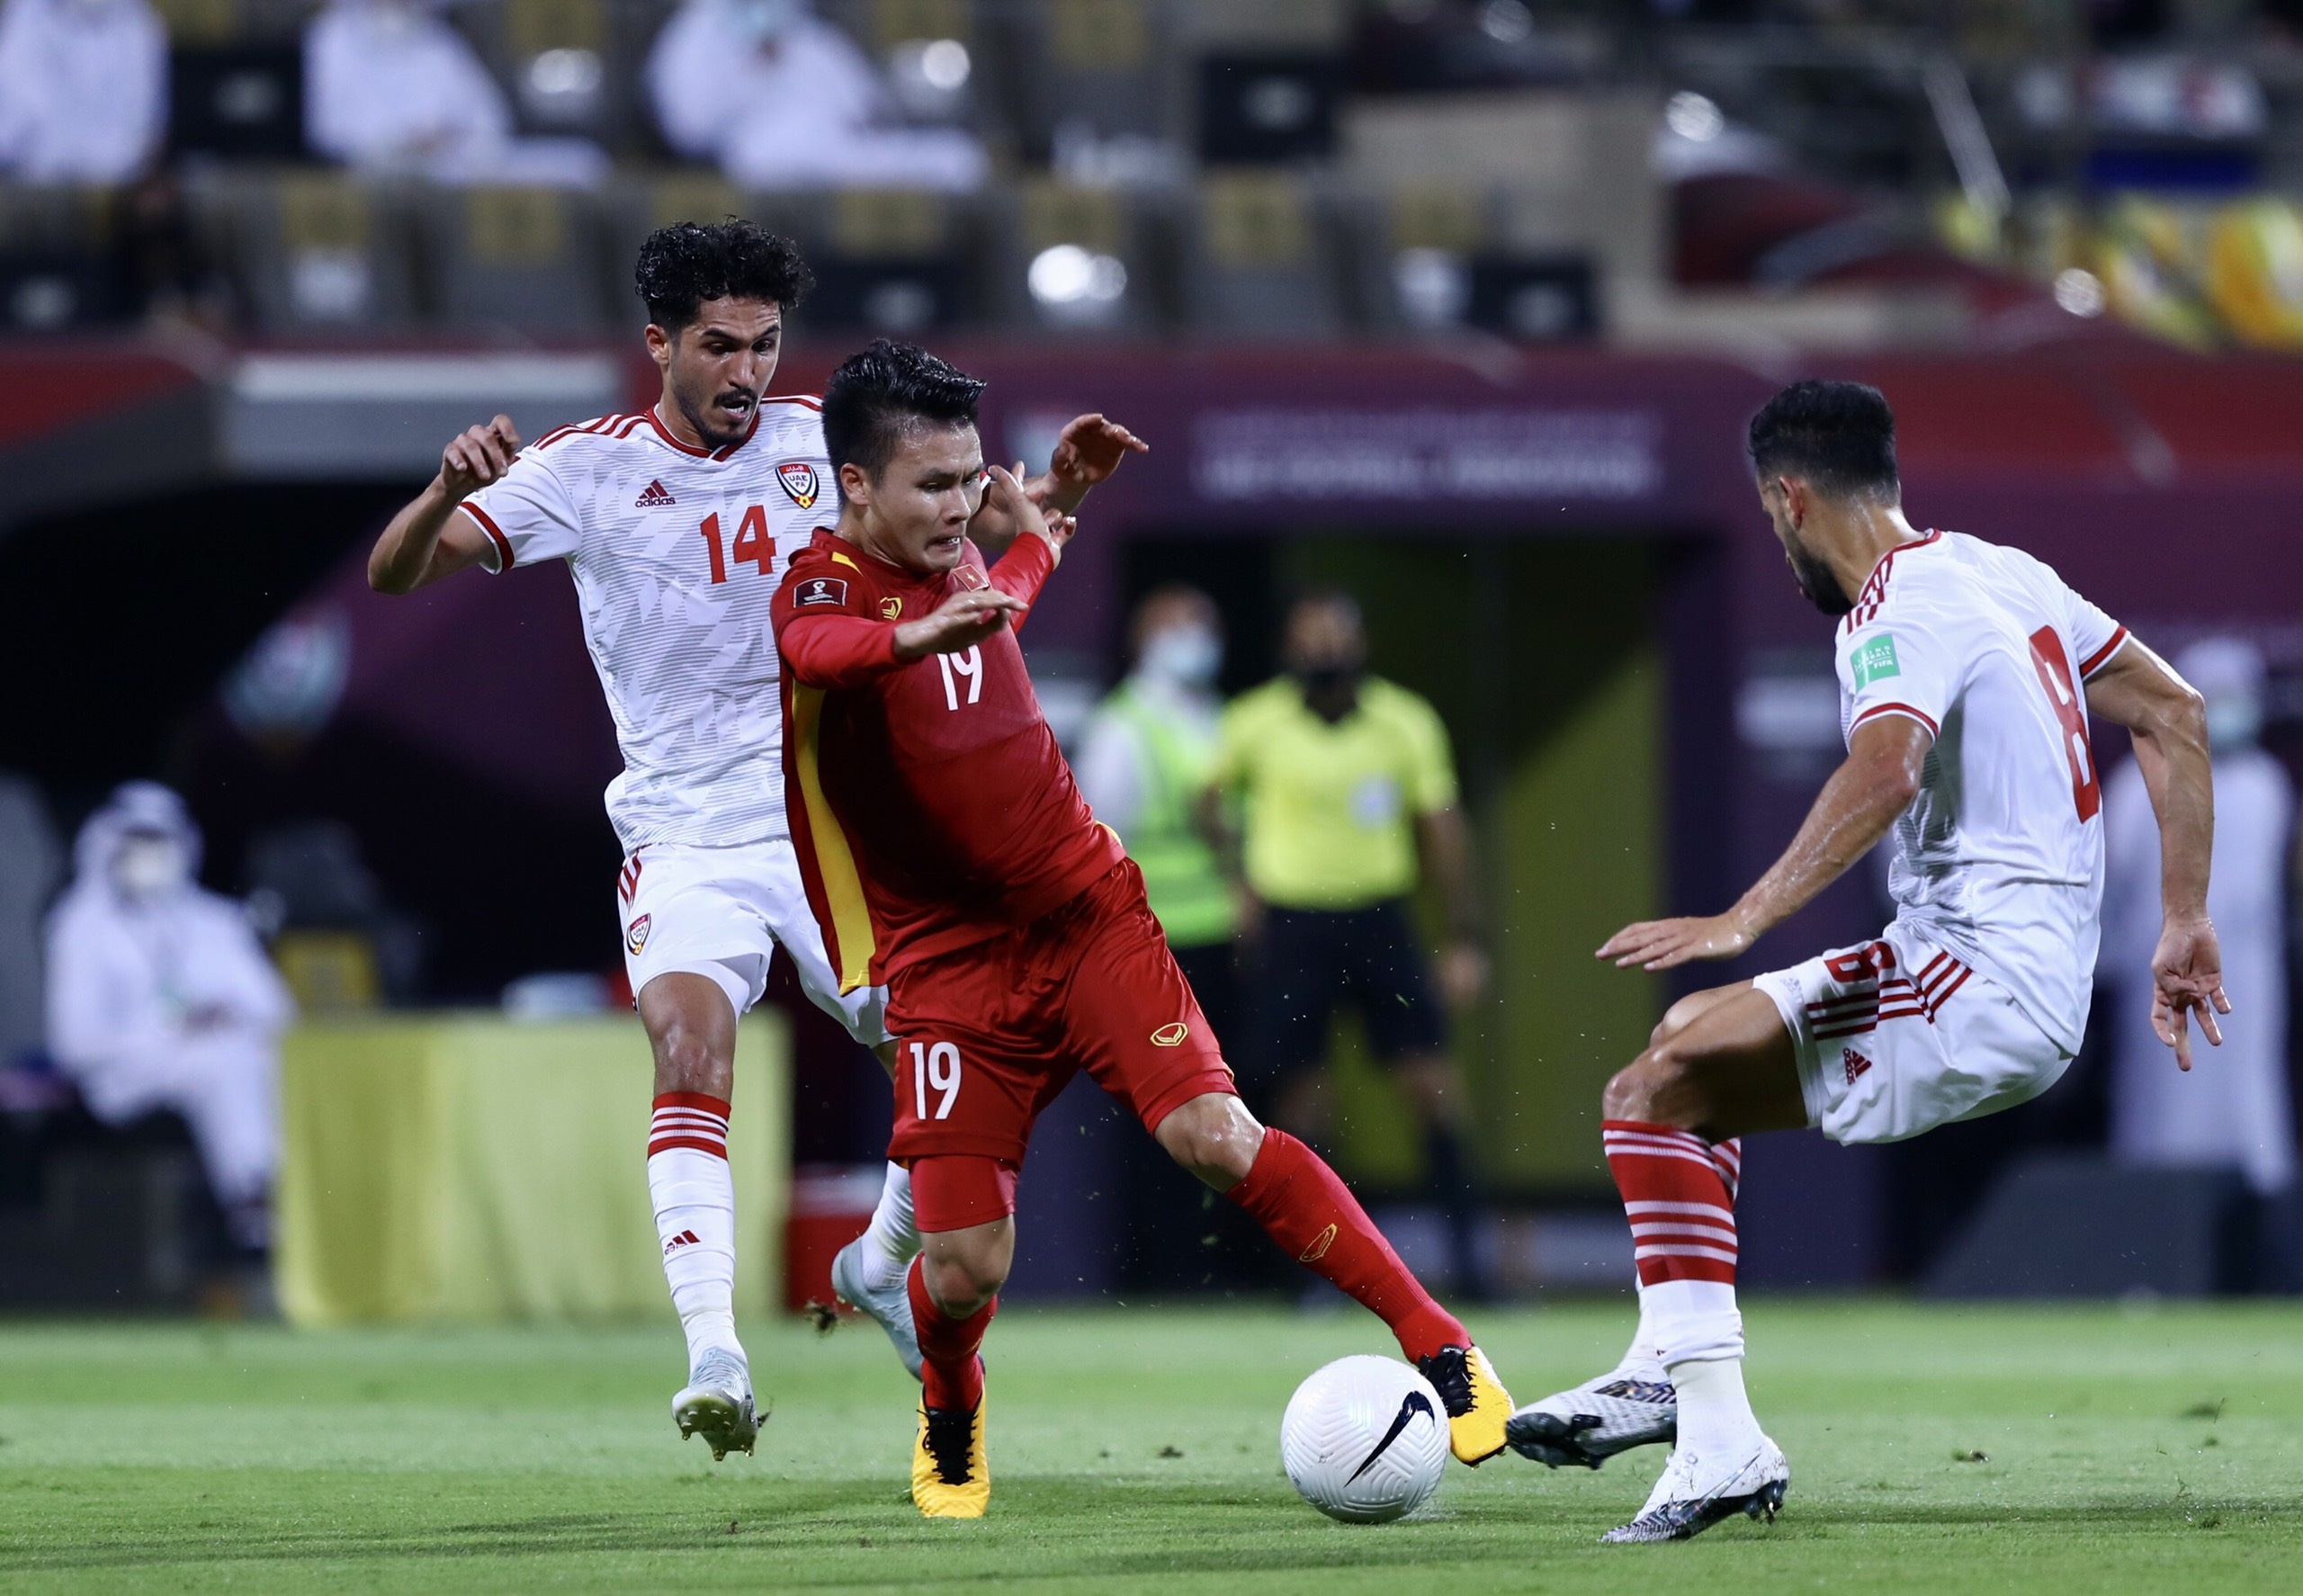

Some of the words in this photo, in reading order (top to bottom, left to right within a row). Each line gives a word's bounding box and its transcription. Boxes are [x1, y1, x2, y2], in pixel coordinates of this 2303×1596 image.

[635, 497, 677, 508] adidas
[700, 505, 776, 585] 14
[936, 644, 982, 711] 19
[2029, 624, 2101, 824] 8
[910, 1041, 961, 1120] 19
